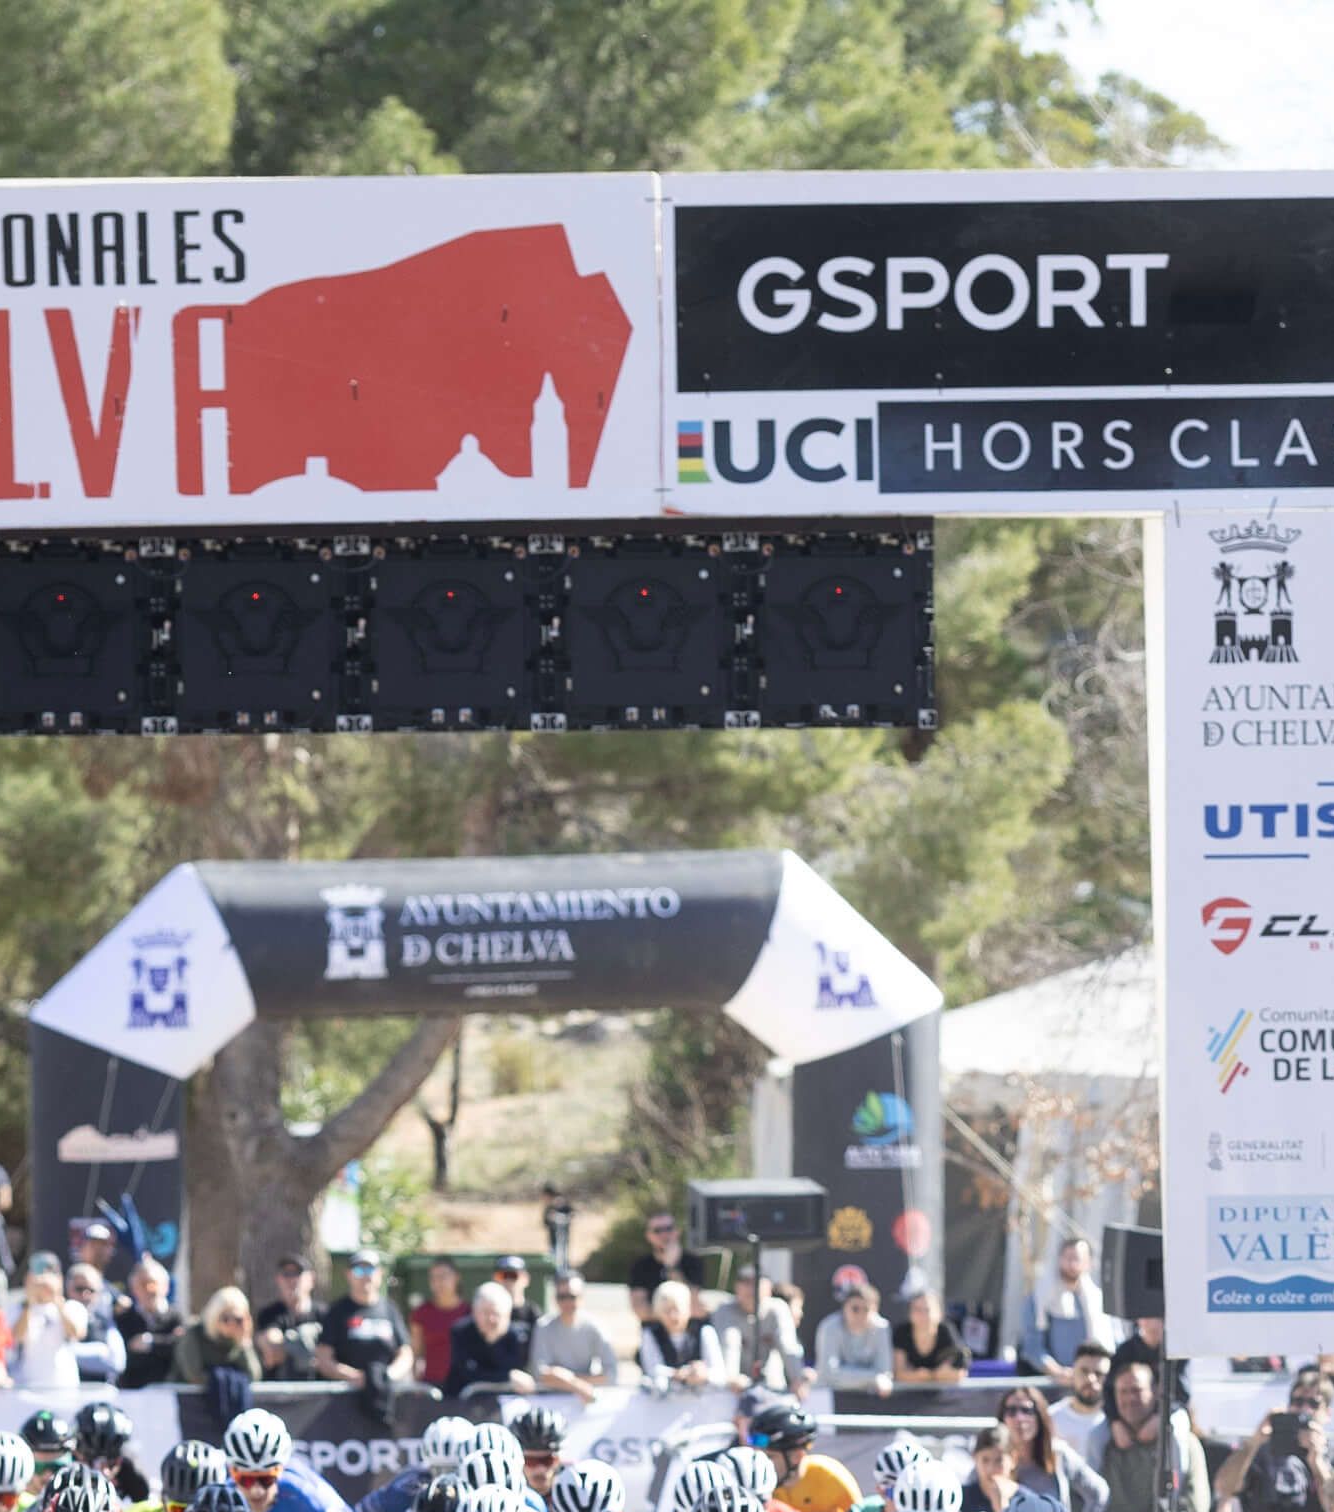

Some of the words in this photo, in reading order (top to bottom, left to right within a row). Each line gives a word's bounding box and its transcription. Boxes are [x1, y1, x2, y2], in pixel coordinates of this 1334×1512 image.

[736, 252, 1170, 335] GSPORT
[712, 417, 874, 486] UCI
[923, 420, 1136, 473] HORS
[398, 886, 681, 927] AYUNTAMIENTO
[435, 929, 577, 965] CHELVA
[1273, 1058, 1312, 1081] DE
[1227, 1139, 1303, 1151] GENERALITAT
